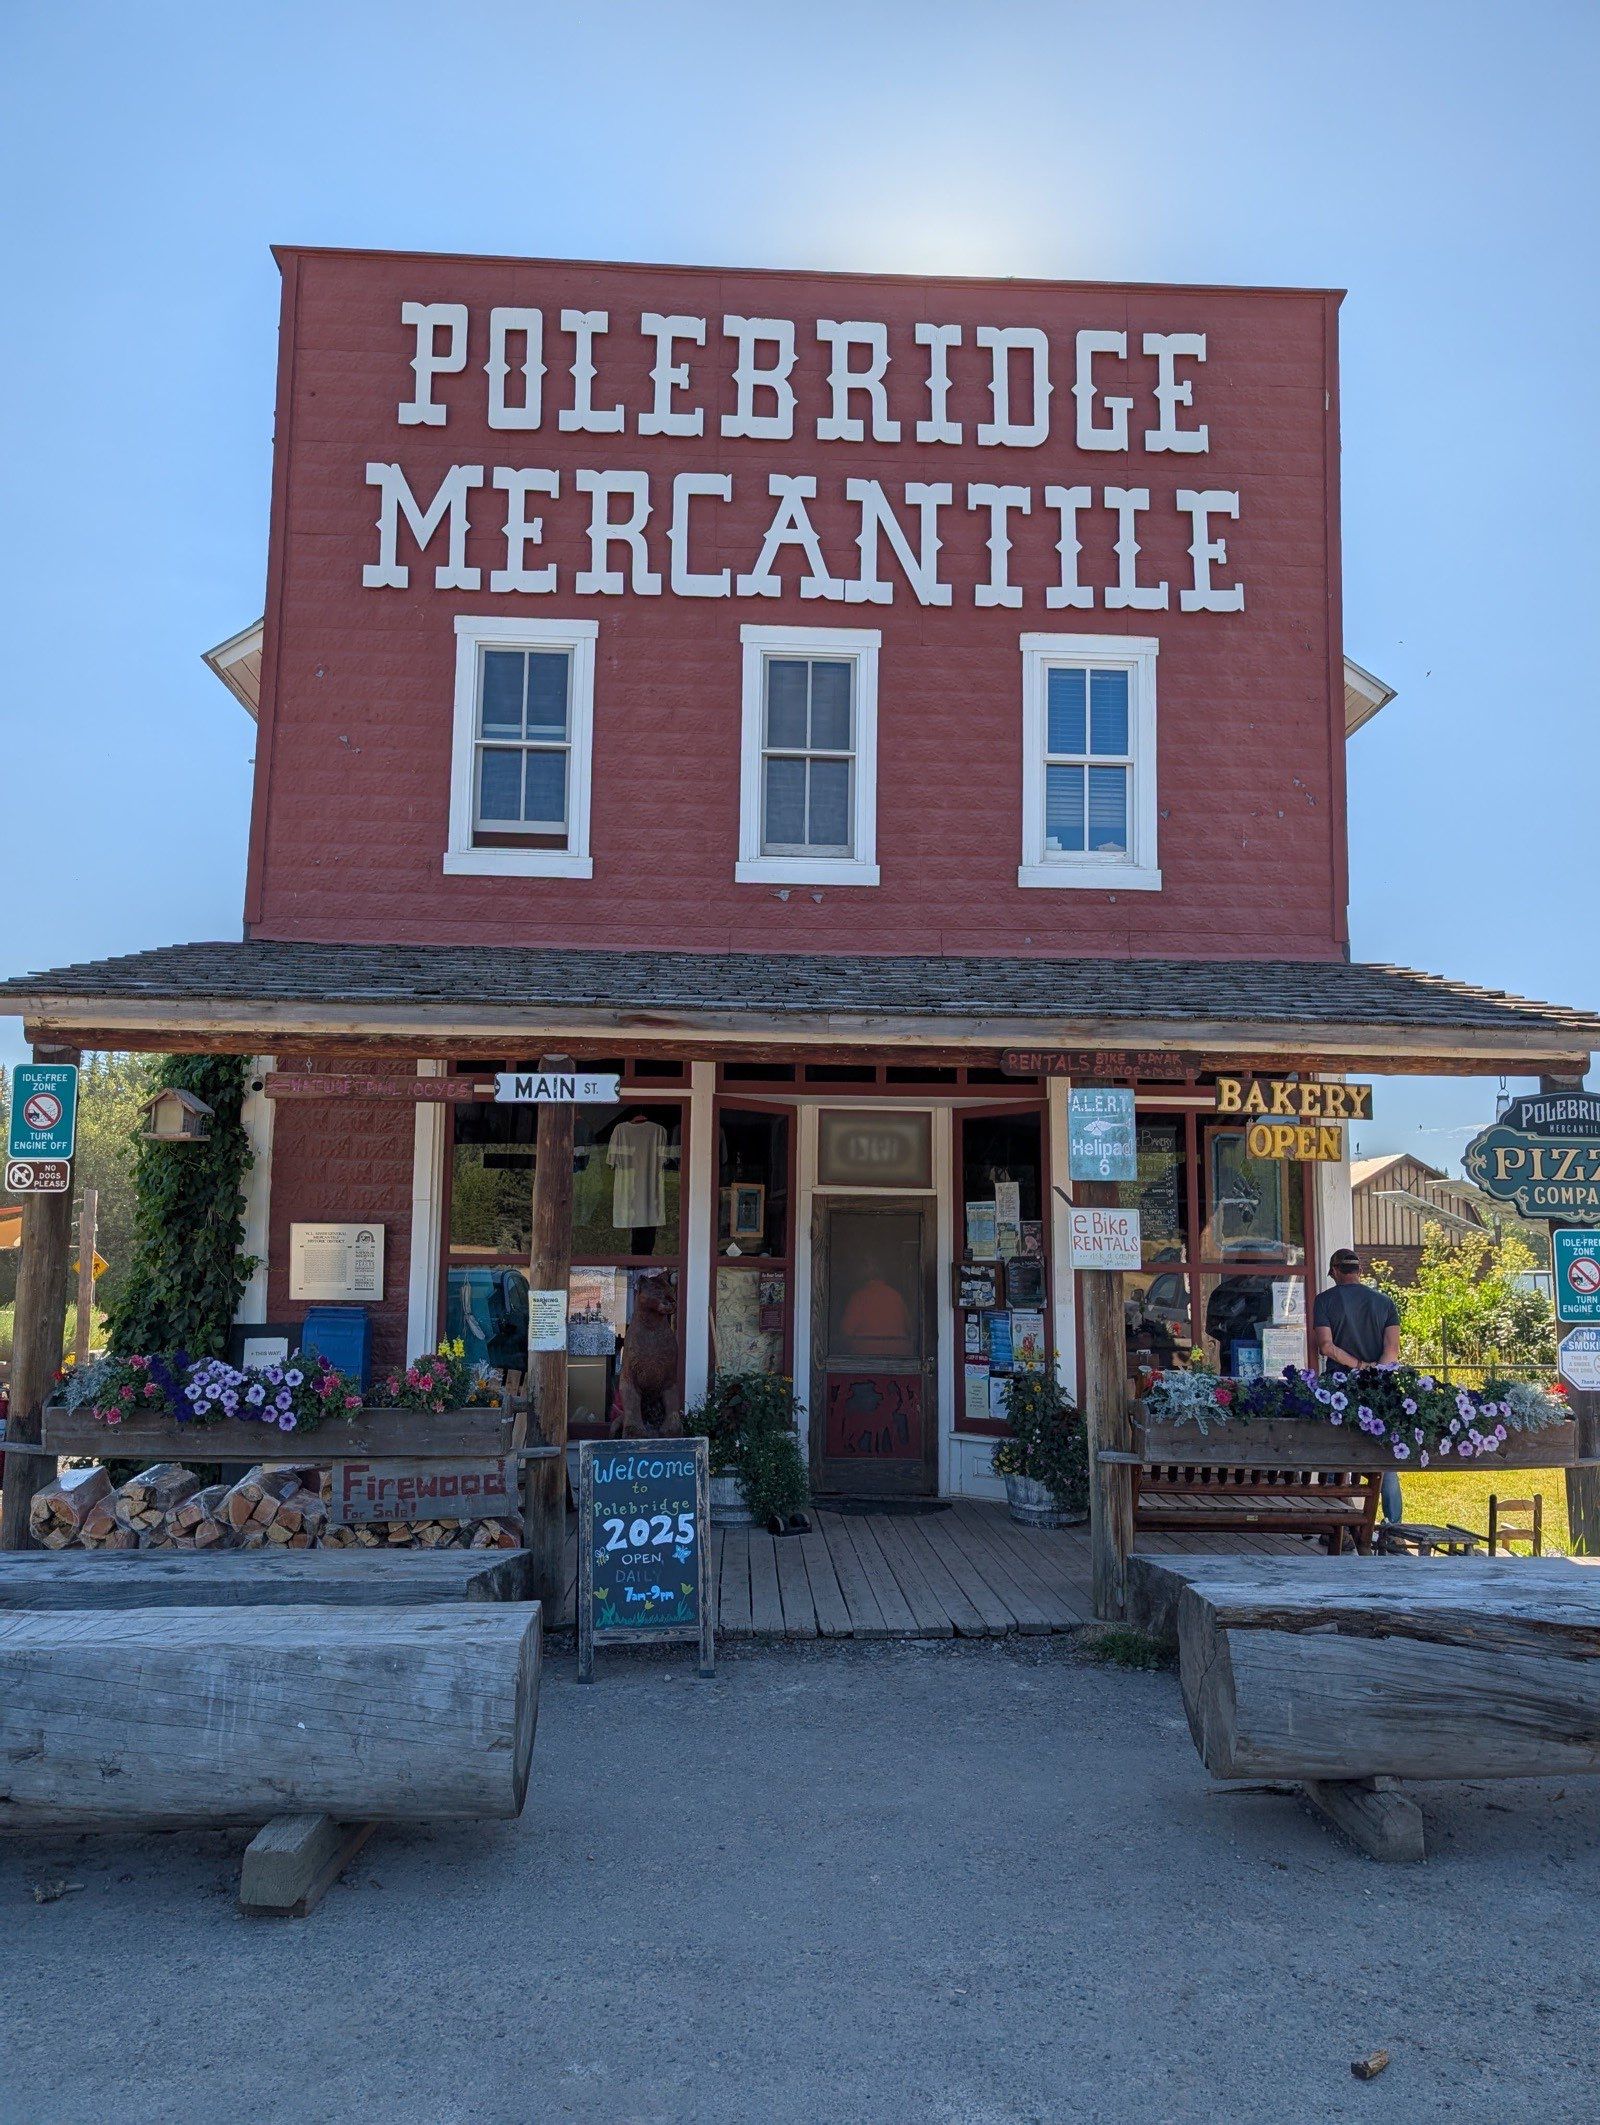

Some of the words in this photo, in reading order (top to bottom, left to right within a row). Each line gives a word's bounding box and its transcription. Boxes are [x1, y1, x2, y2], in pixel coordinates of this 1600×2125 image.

[398, 302, 1210, 453] POLEBRIDGE
[362, 462, 1244, 613] MERCANTILE
[1007, 1053, 1091, 1072] RENTALS
[1095, 1052, 1127, 1065] BIKE
[22, 1073, 68, 1082] IDLE-FREE
[1094, 1065, 1141, 1077] CANOE
[32, 1082, 57, 1091] ZONE
[515, 1076, 575, 1099] MAIN
[584, 1083, 599, 1095] ST.
[1071, 1095, 1132, 1112] A.L.E.R.T.
[1217, 1078, 1371, 1117] BAKERY
[30, 1132, 54, 1141] TURN
[1248, 1124, 1342, 1160] OPEN
[14, 1141, 47, 1150] ENGINE
[50, 1141, 68, 1150] OFF
[1072, 1138, 1135, 1157] Helipad
[1099, 1159, 1110, 1176] 6
[34, 1180, 66, 1188] PLEASE
[39, 1172, 61, 1180] DOGS
[1534, 1186, 1600, 1204] COMPA
[1074, 1215, 1087, 1234] e
[1093, 1212, 1128, 1236] Bike
[1073, 1236, 1139, 1251] RENTALS
[1573, 1248, 1595, 1256] ZONE
[1576, 1296, 1598, 1304] TURN
[1563, 1305, 1593, 1313] ENGINE
[1583, 1332, 1597, 1341] NO
[1568, 1341, 1599, 1351] SMOKI
[592, 1457, 695, 1483] Welcome
[342, 1459, 507, 1501] Firewood
[632, 1482, 648, 1494] to
[594, 1499, 690, 1517] Polebridge
[602, 1513, 695, 1552] 2025
[621, 1553, 662, 1565] OPEN
[624, 1585, 674, 1603] 7am-9pm
